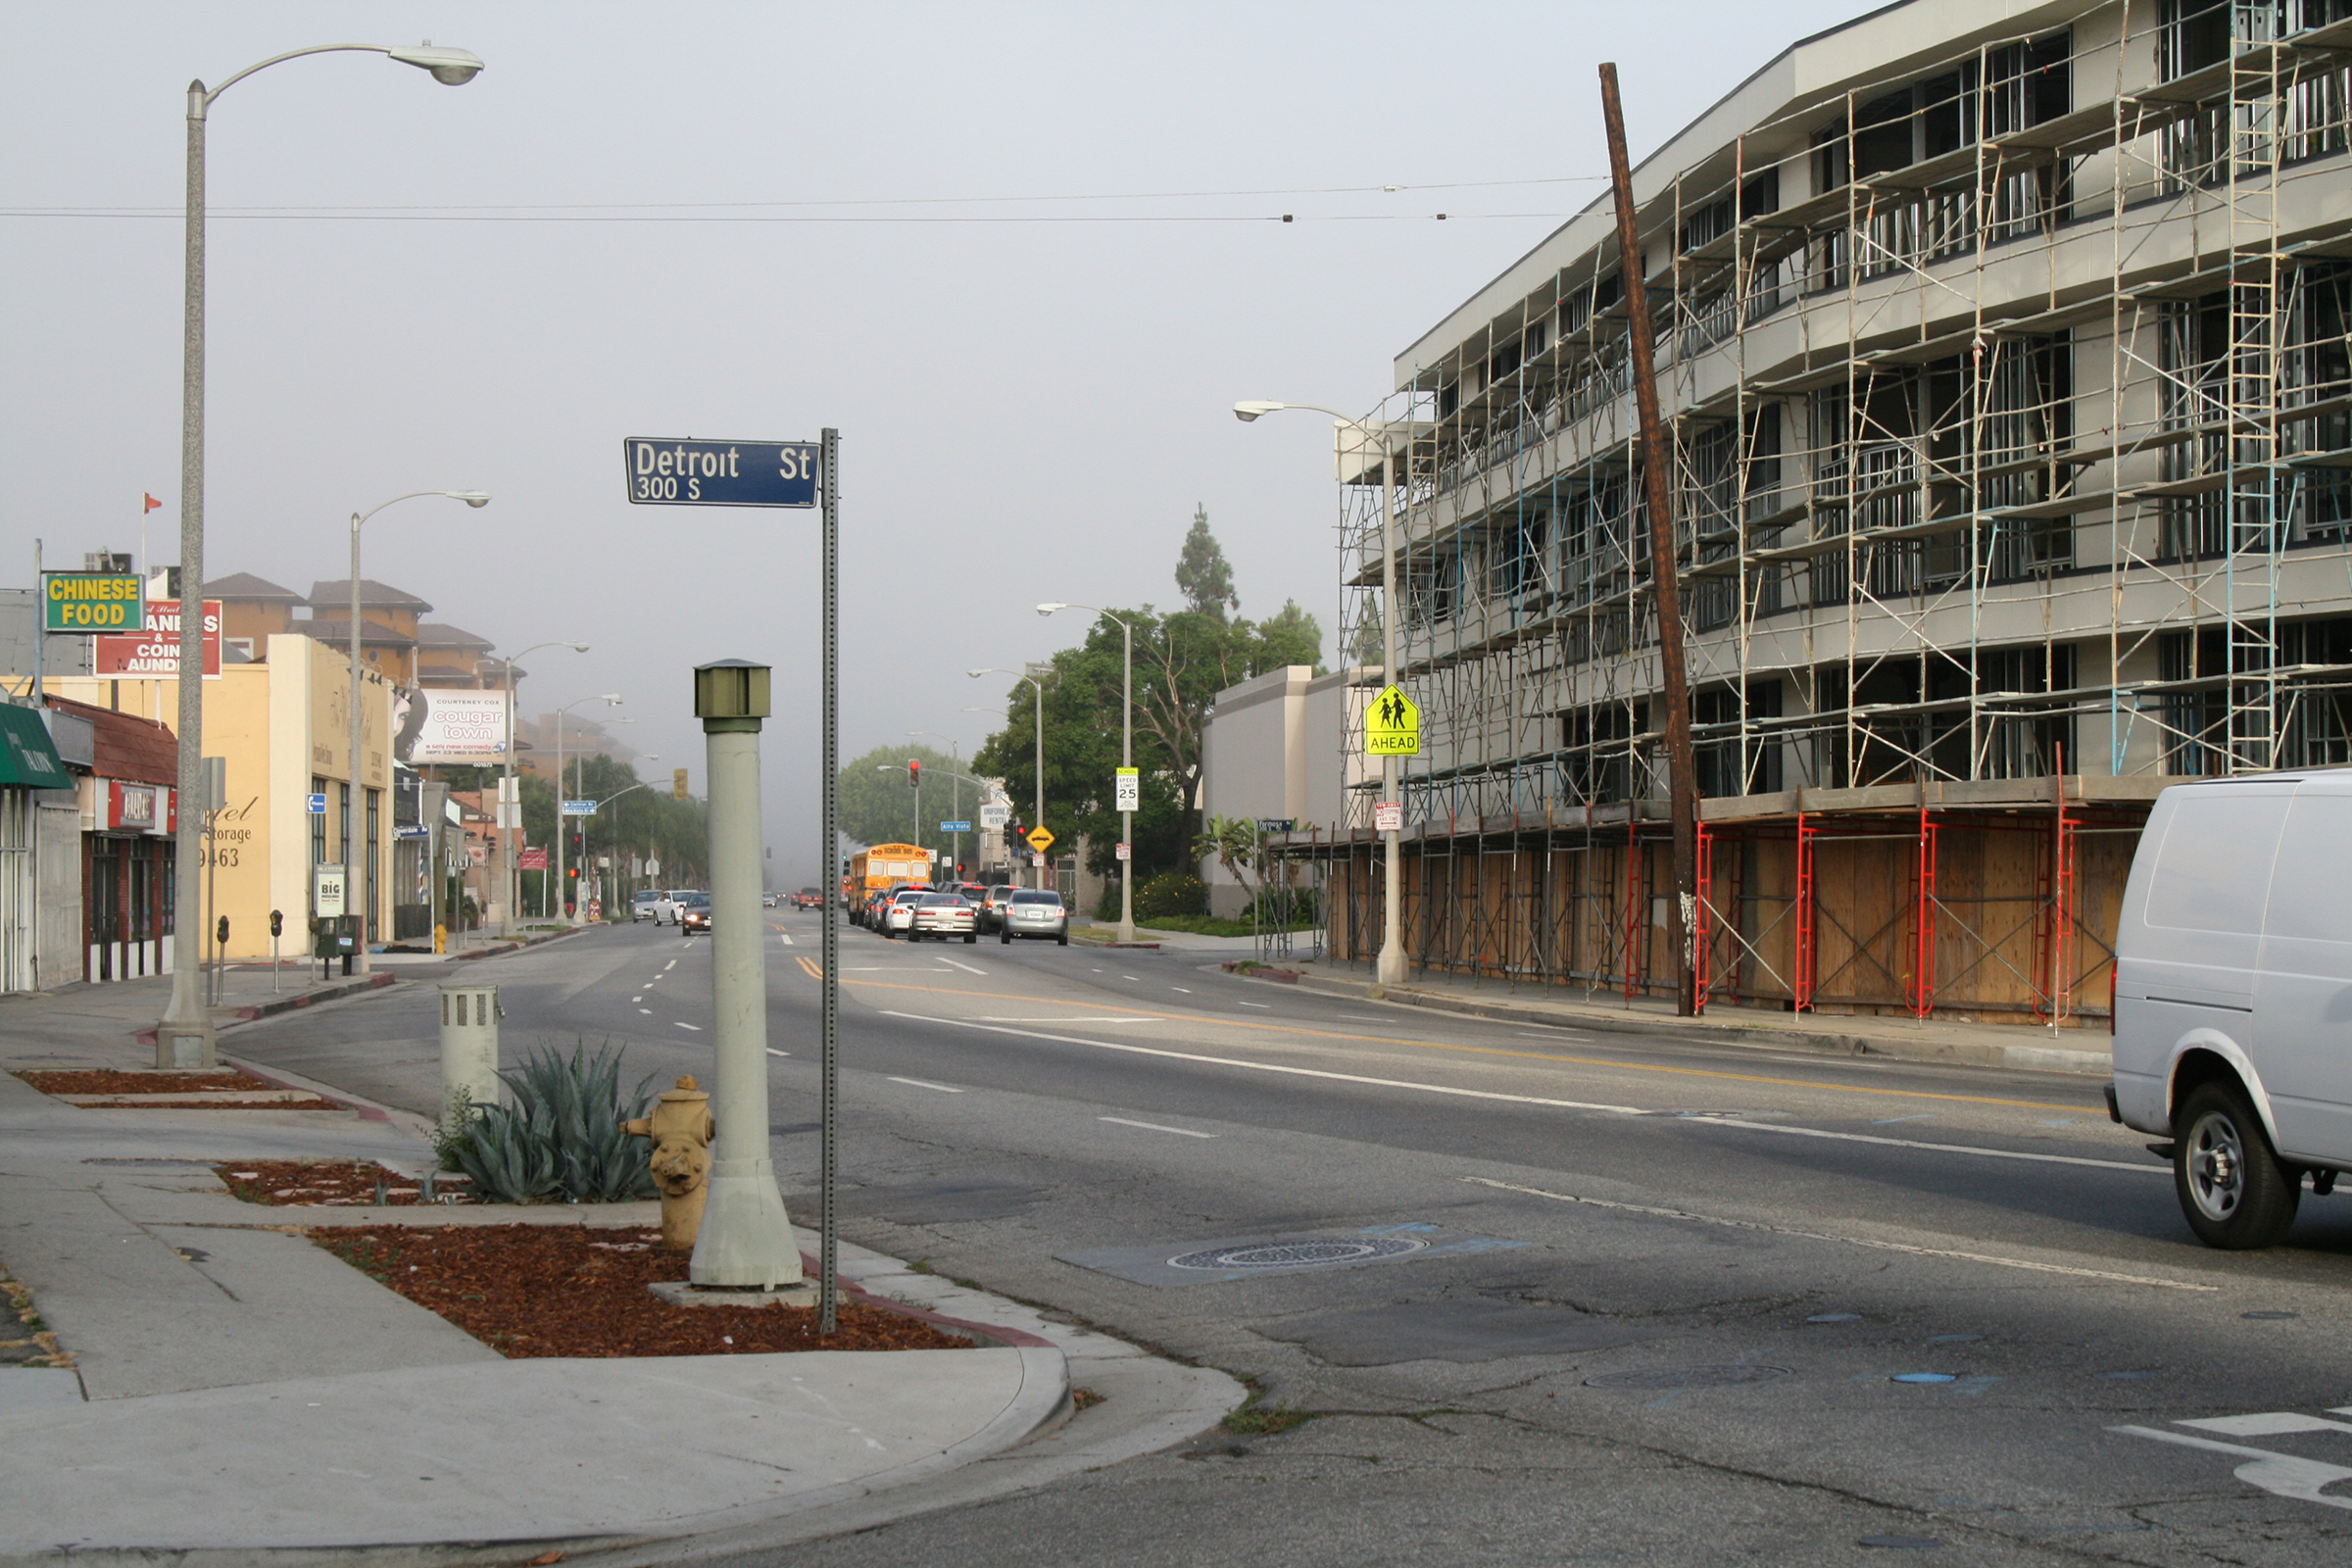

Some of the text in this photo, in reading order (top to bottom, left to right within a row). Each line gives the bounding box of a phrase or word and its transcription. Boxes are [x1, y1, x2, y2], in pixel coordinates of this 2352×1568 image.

[637, 443, 811, 480] Detroit St
[637, 476, 701, 500] 300 S
[49, 579, 138, 601] CHINESE
[62, 604, 125, 625] FOOD
[154, 633, 164, 643] &
[137, 644, 181, 658] COIN
[433, 710, 504, 727] cougar
[443, 724, 493, 740] town
[1371, 737, 1415, 749] AHEAD
[1119, 789, 1137, 799] 25
[321, 880, 340, 894] BIG
